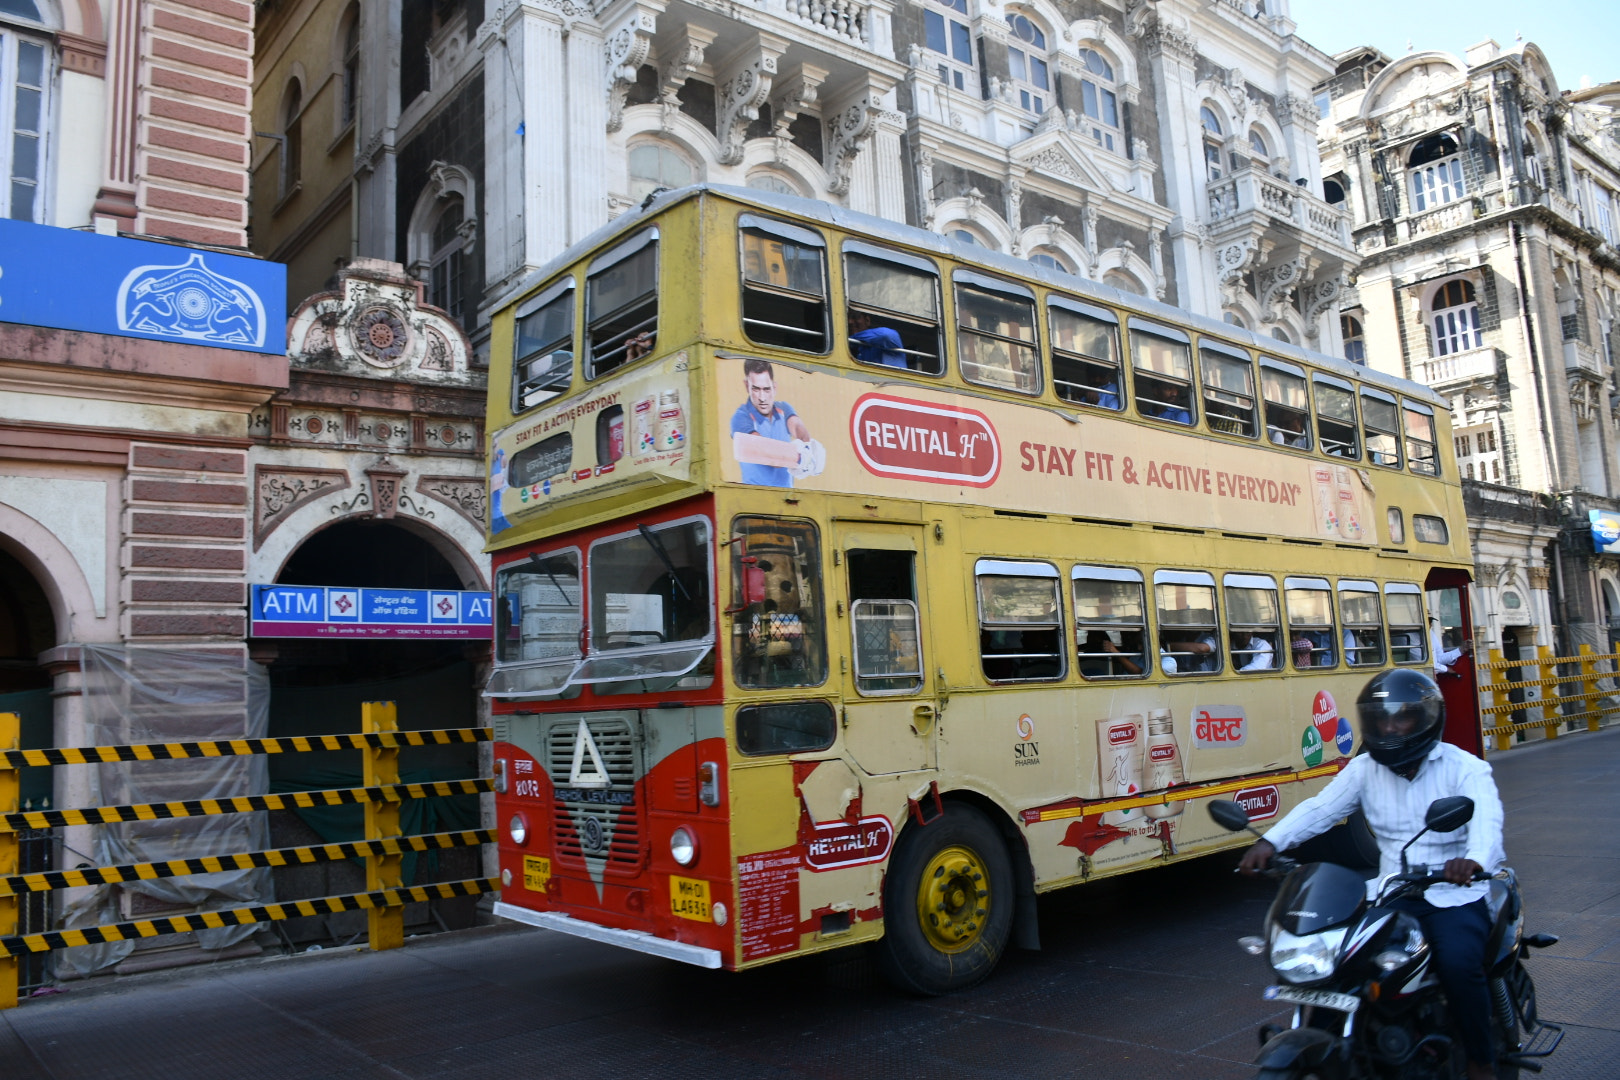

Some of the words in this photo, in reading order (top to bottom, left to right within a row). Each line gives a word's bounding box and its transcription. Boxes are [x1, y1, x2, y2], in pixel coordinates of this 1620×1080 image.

[515, 428, 532, 445] STAY
[533, 424, 542, 437] FIT
[543, 420, 550, 432] &
[551, 408, 576, 429] ACTIVE
[865, 420, 956, 457] REVITAL
[1020, 441, 1077, 477] STAY
[1084, 451, 1114, 481] FIT
[1122, 456, 1140, 485] &
[1146, 460, 1212, 495] ACTIVE
[262, 591, 318, 614] ATM
[1320, 698, 1327, 712] 10
[1196, 711, 1243, 742] बेस्ट
[1313, 707, 1337, 727] Vitamins
[1308, 732, 1313, 744] 9
[1014, 742, 1039, 759] SUN
[1302, 740, 1322, 758] Minerals
[1015, 758, 1040, 767] PHARMA
[554, 789, 583, 801] ASHOK
[587, 791, 634, 804] LEYLAND
